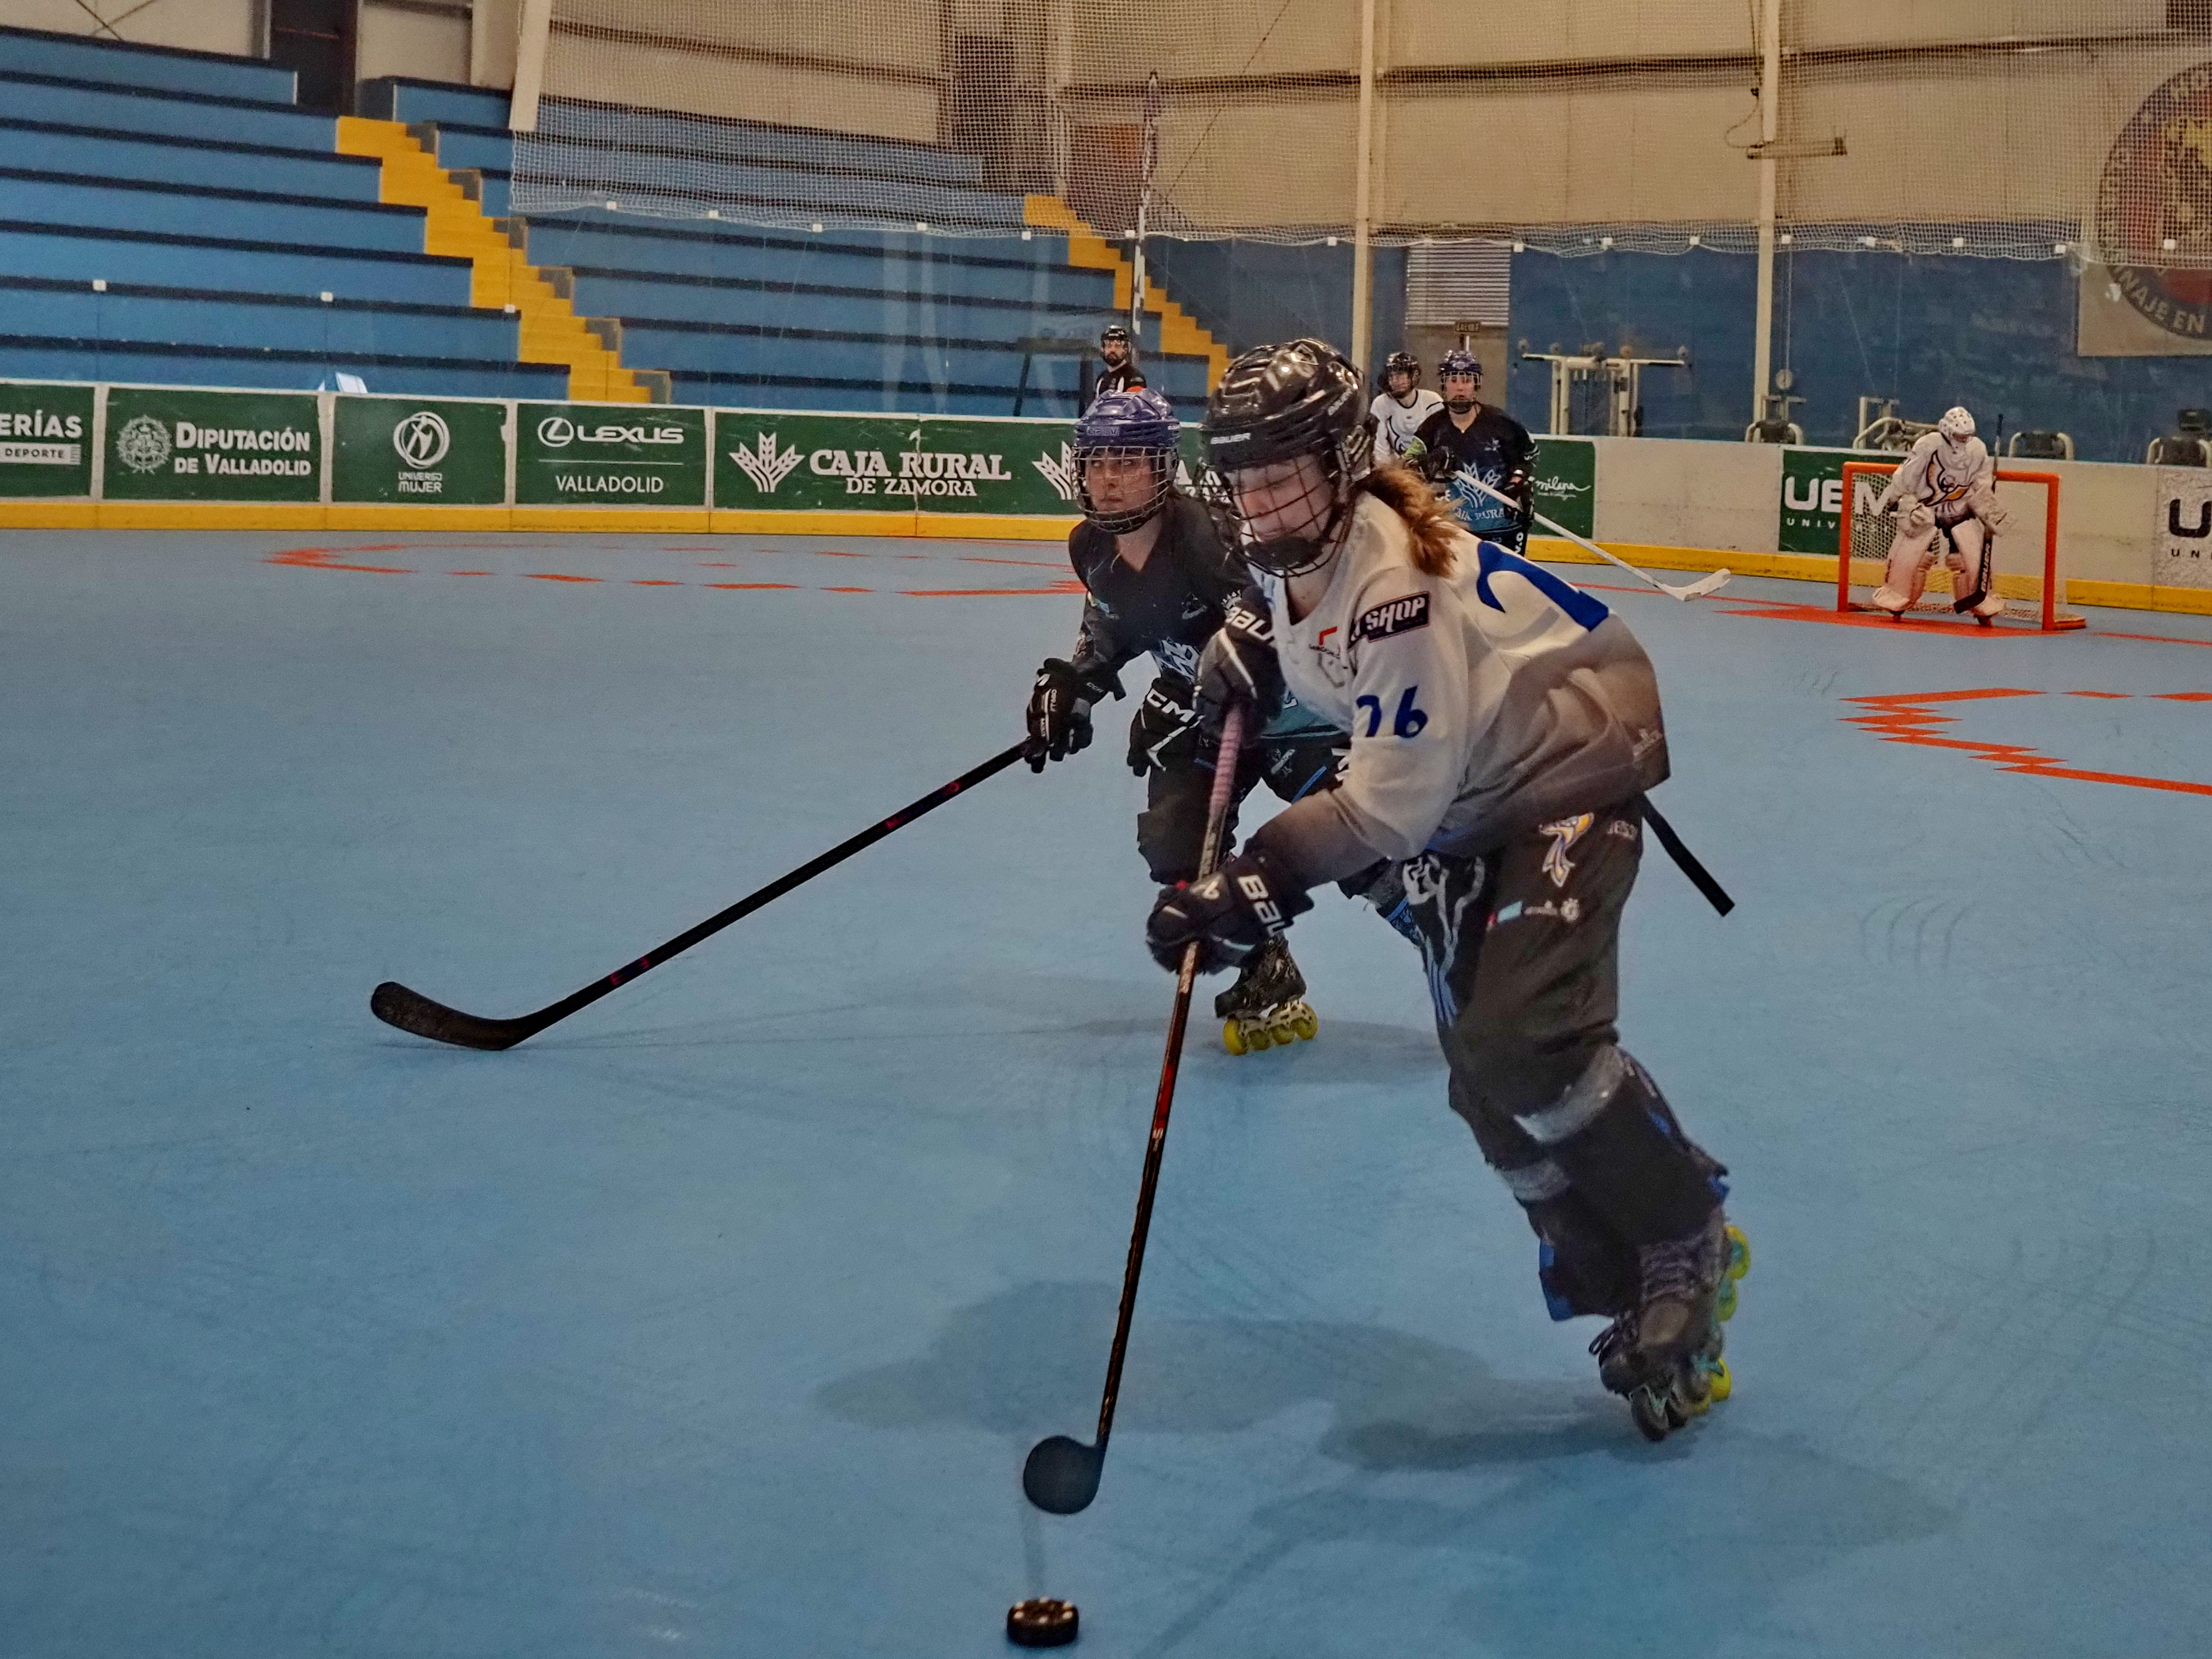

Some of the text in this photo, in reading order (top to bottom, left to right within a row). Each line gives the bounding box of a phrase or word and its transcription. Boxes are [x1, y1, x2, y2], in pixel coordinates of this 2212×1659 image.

[176, 422, 310, 451] DIPUTACIÓN
[577, 425, 684, 444] LEXUS
[5, 448, 64, 459] DEPORTE
[175, 453, 311, 476] DE VALLADOLID
[810, 449, 1012, 480] CAJA RURAL
[398, 472, 443, 481] UNIVERSO
[556, 476, 664, 492] VALLADOLID
[398, 480, 443, 493] MUJER
[846, 478, 977, 496] DE ZAMORA
[1365, 597, 1426, 633] SHOP
